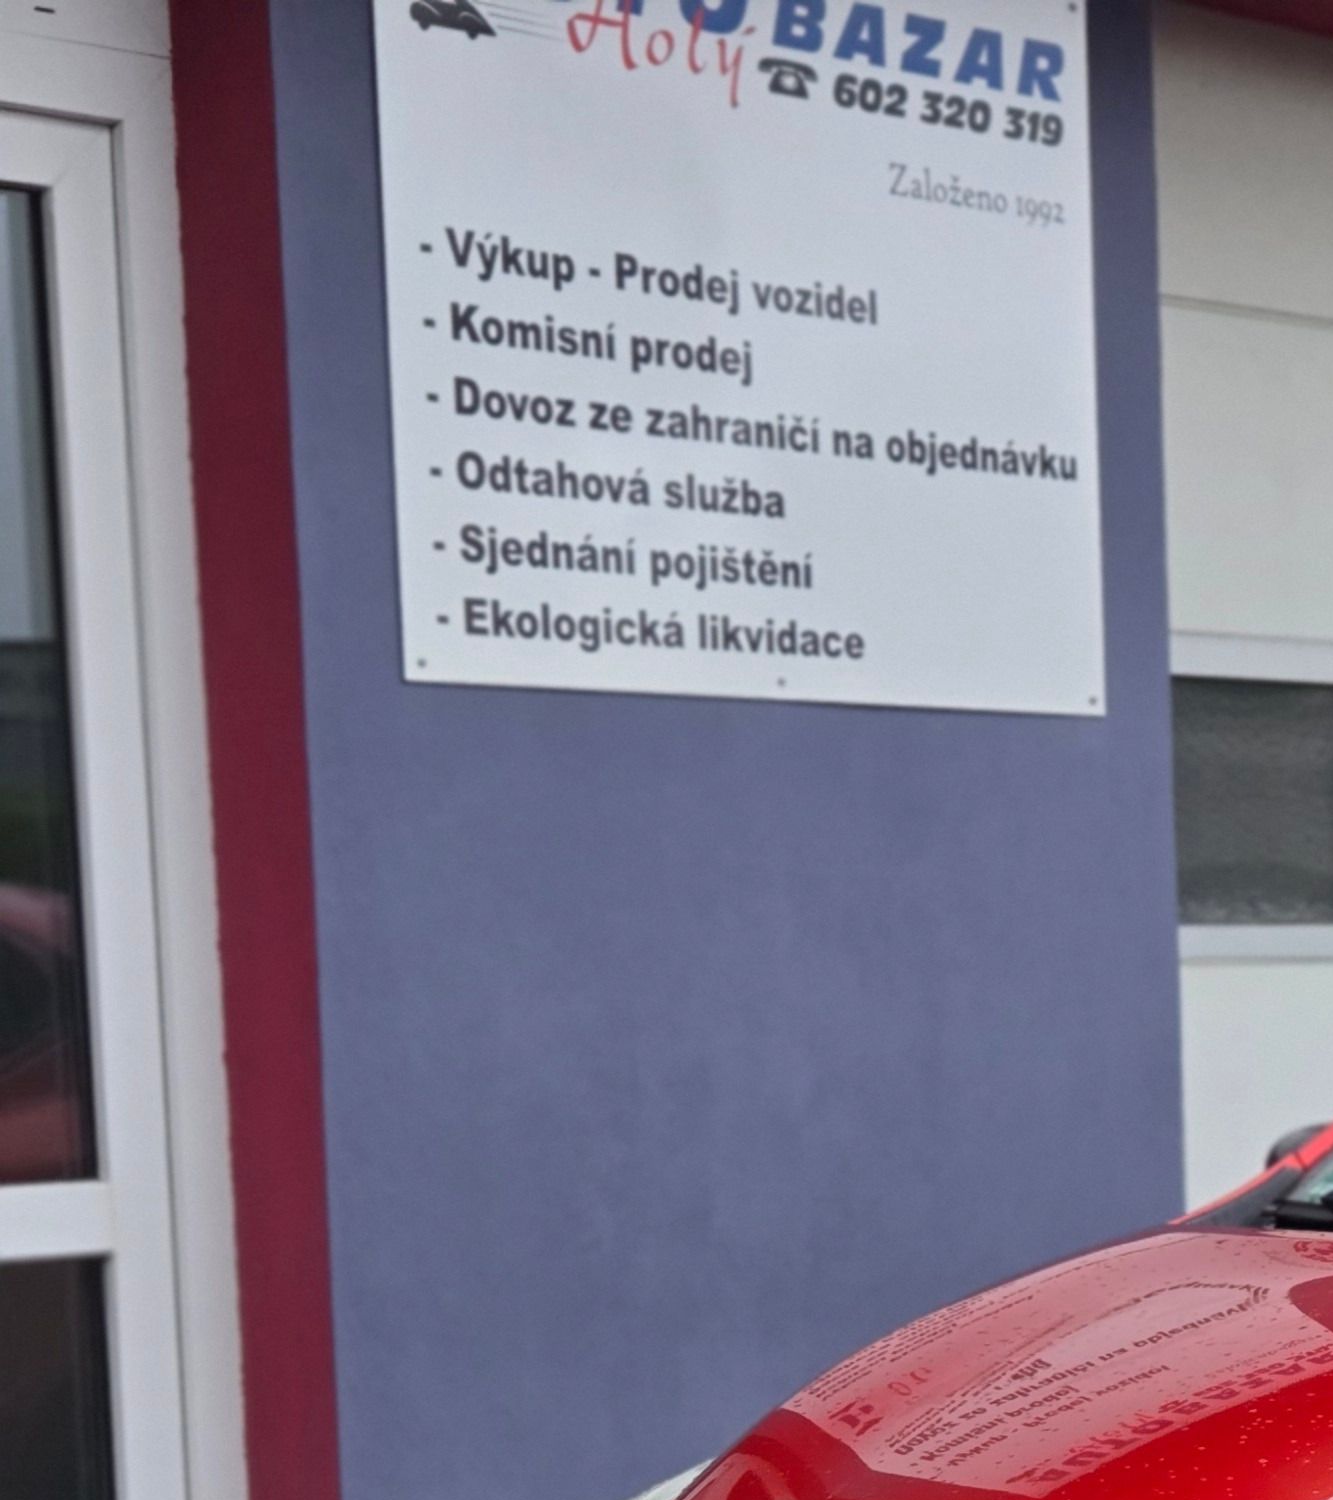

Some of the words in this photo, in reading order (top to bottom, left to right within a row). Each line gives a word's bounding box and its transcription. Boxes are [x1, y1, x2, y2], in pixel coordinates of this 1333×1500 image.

[832, 72, 909, 119] 602
[919, 89, 993, 135] 320
[1002, 105, 1065, 148] 319
[888, 162, 1009, 215] Založeno
[1015, 195, 1066, 228] 1992
[444, 226, 576, 293] Výkup
[613, 251, 740, 317] Prodej
[751, 281, 878, 326] vozidel
[449, 301, 617, 362] Komisní
[629, 335, 753, 388] prodej
[452, 375, 577, 429] Dovoz
[588, 401, 634, 435] ze
[645, 403, 821, 455] zahraničí
[831, 429, 875, 461] na
[885, 428, 1079, 482] objednávku
[455, 449, 651, 507] Odtahová
[663, 473, 787, 520] služba
[459, 523, 636, 576] Sjednání
[649, 543, 813, 592] pojištění
[462, 596, 686, 654] Ekologická
[697, 613, 866, 661] likvidace
